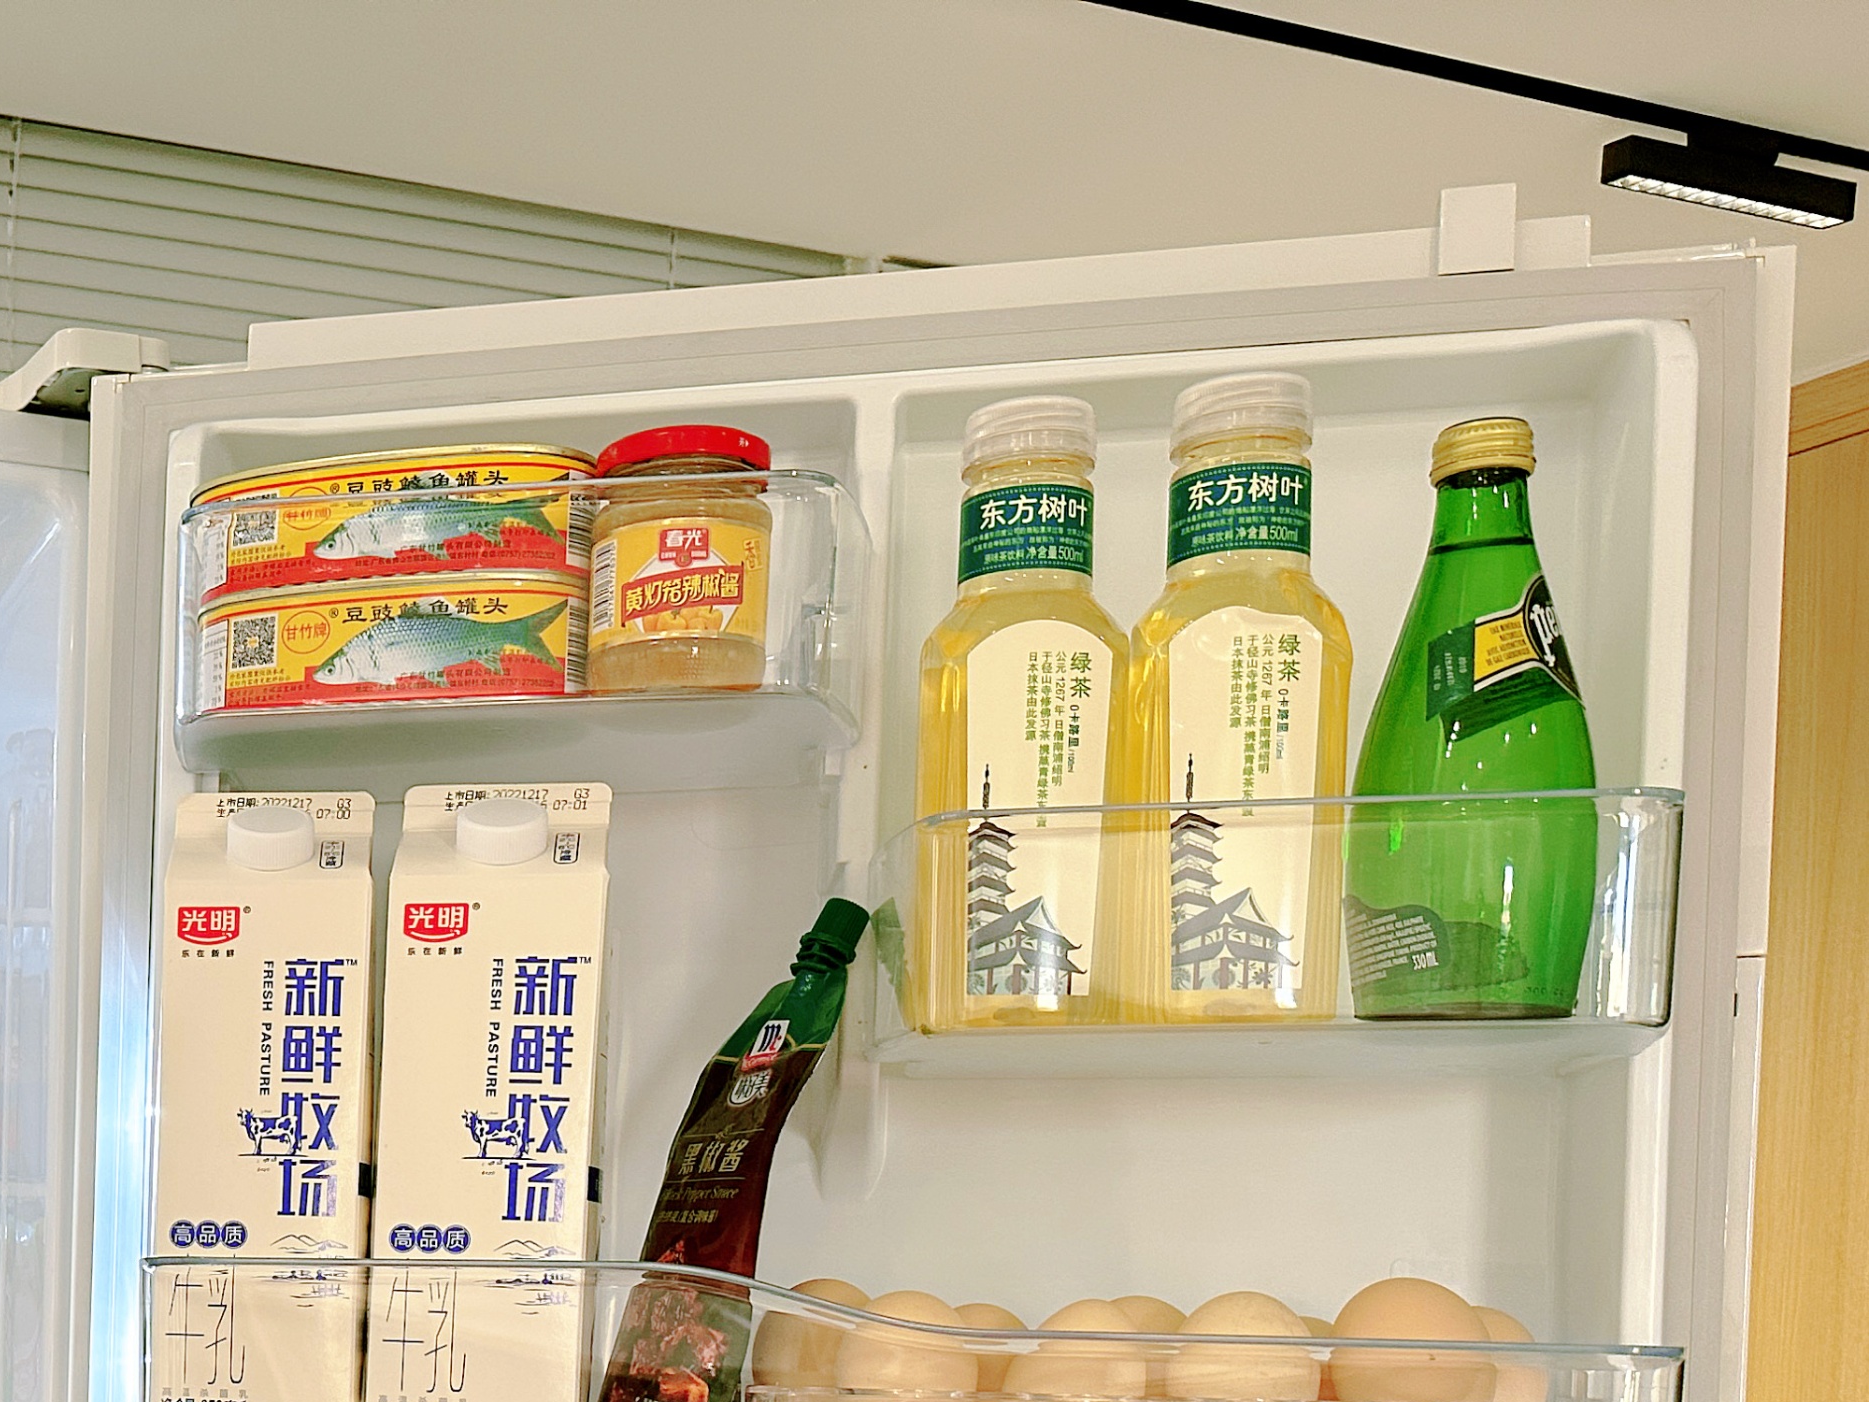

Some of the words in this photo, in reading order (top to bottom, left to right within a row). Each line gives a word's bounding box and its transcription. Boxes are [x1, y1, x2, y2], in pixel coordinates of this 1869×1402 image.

[980, 493, 1088, 530] 东方树叶
[1187, 472, 1303, 512] 东方树叶
[665, 529, 704, 548] 春光
[625, 568, 740, 616] 黄灯笼辣椒酱
[285, 622, 328, 642] 甘竹牌
[1069, 652, 1092, 698] 绿茶
[1277, 634, 1301, 682] 绿茶
[182, 910, 236, 932] 光明
[408, 906, 464, 929] 光明
[262, 960, 274, 1012] FRESH
[490, 958, 504, 1011] FRESH
[259, 1022, 272, 1097] PASTURE
[485, 1021, 500, 1098] PASTURE
[277, 958, 345, 1217] 新鲜牧场
[501, 956, 578, 1222] 新鲜牧场
[678, 1139, 749, 1176] 黑椒酱
[174, 1223, 245, 1245] 高品质
[393, 1227, 467, 1250] 高品质
[165, 1255, 246, 1385] 牛乳
[382, 1260, 467, 1393] 牛乳
